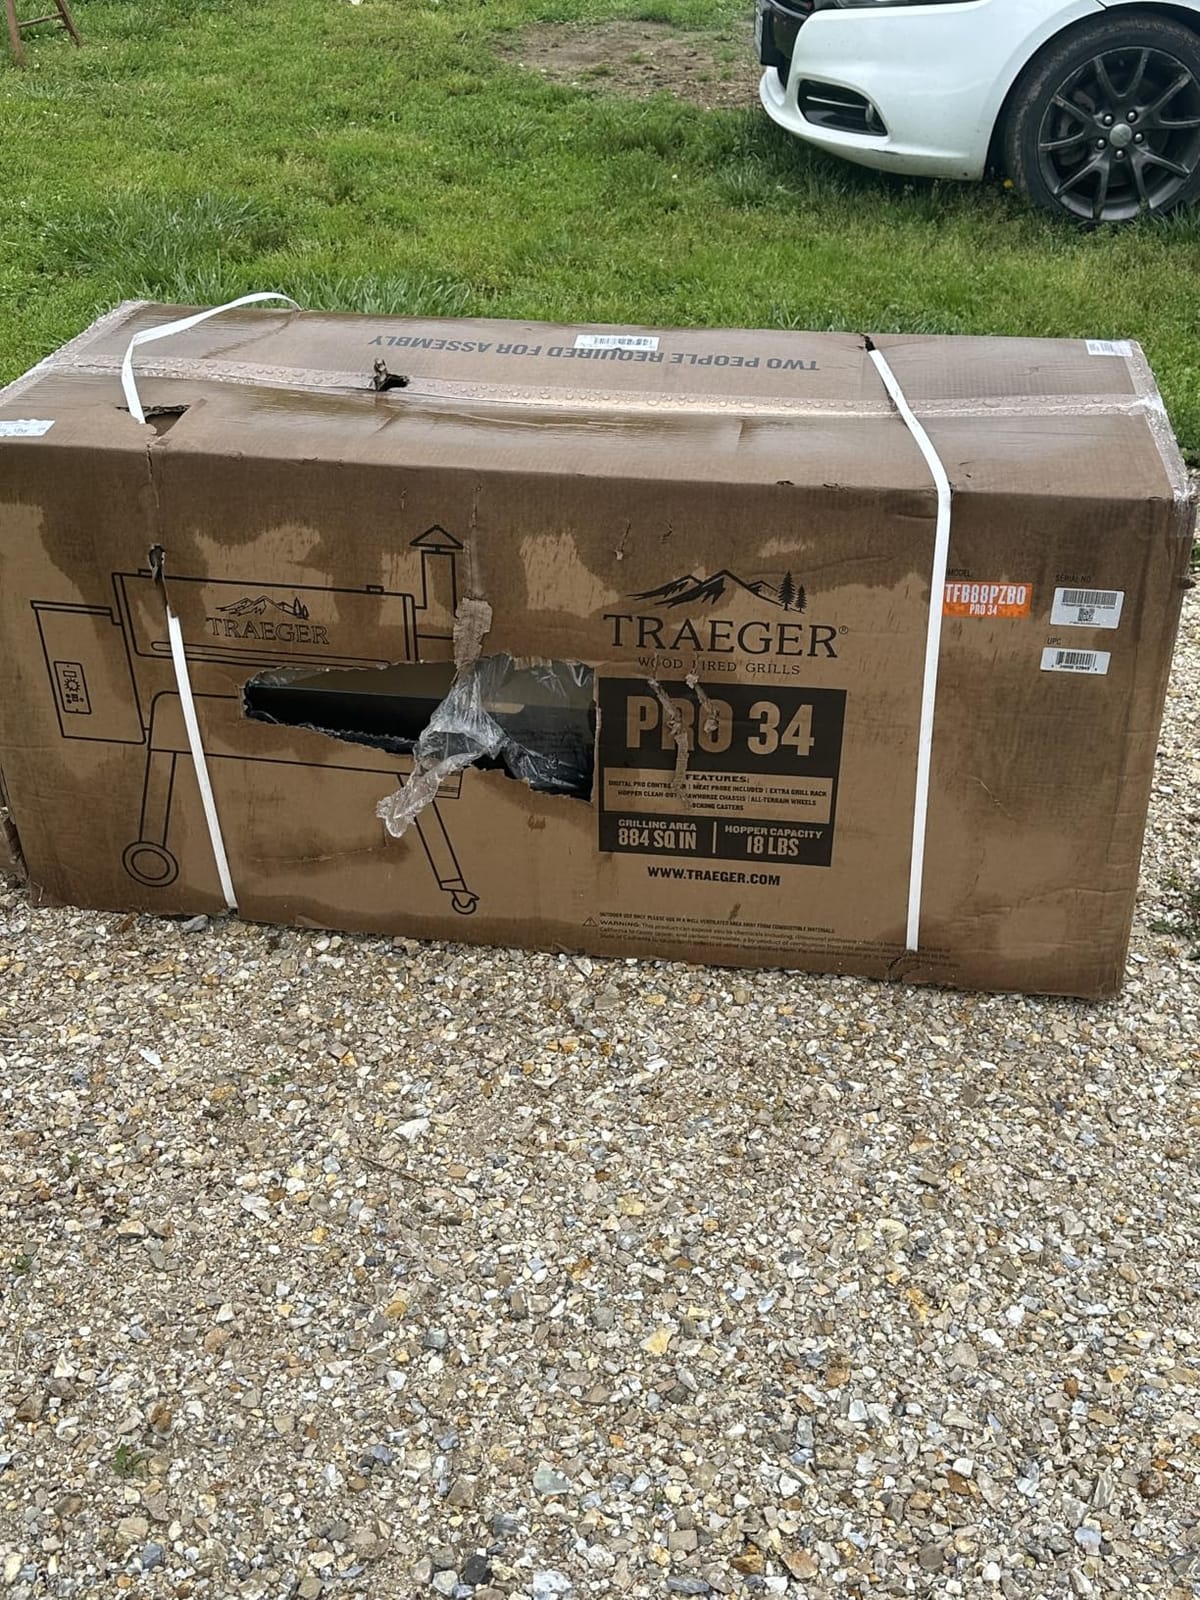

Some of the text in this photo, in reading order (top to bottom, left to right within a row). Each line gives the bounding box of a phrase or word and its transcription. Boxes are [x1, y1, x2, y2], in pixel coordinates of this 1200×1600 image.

[368, 335, 820, 371] TWO PEOPLE REQUIRED FOR ASSEMBLY
[968, 604, 998, 616] PRO 34
[205, 617, 330, 645] TRAEGER
[745, 662, 800, 674] GRILLS
[626, 696, 815, 756] PRO 34
[685, 774, 749, 783] FEATURES:
[618, 818, 697, 831] GRILLING AREA
[724, 824, 823, 839] HOPPER CAPACITY
[618, 828, 697, 850] 884 SQ IN
[746, 836, 799, 856] 18 LBS
[647, 866, 780, 886] WWW.TRAEGER.COM
